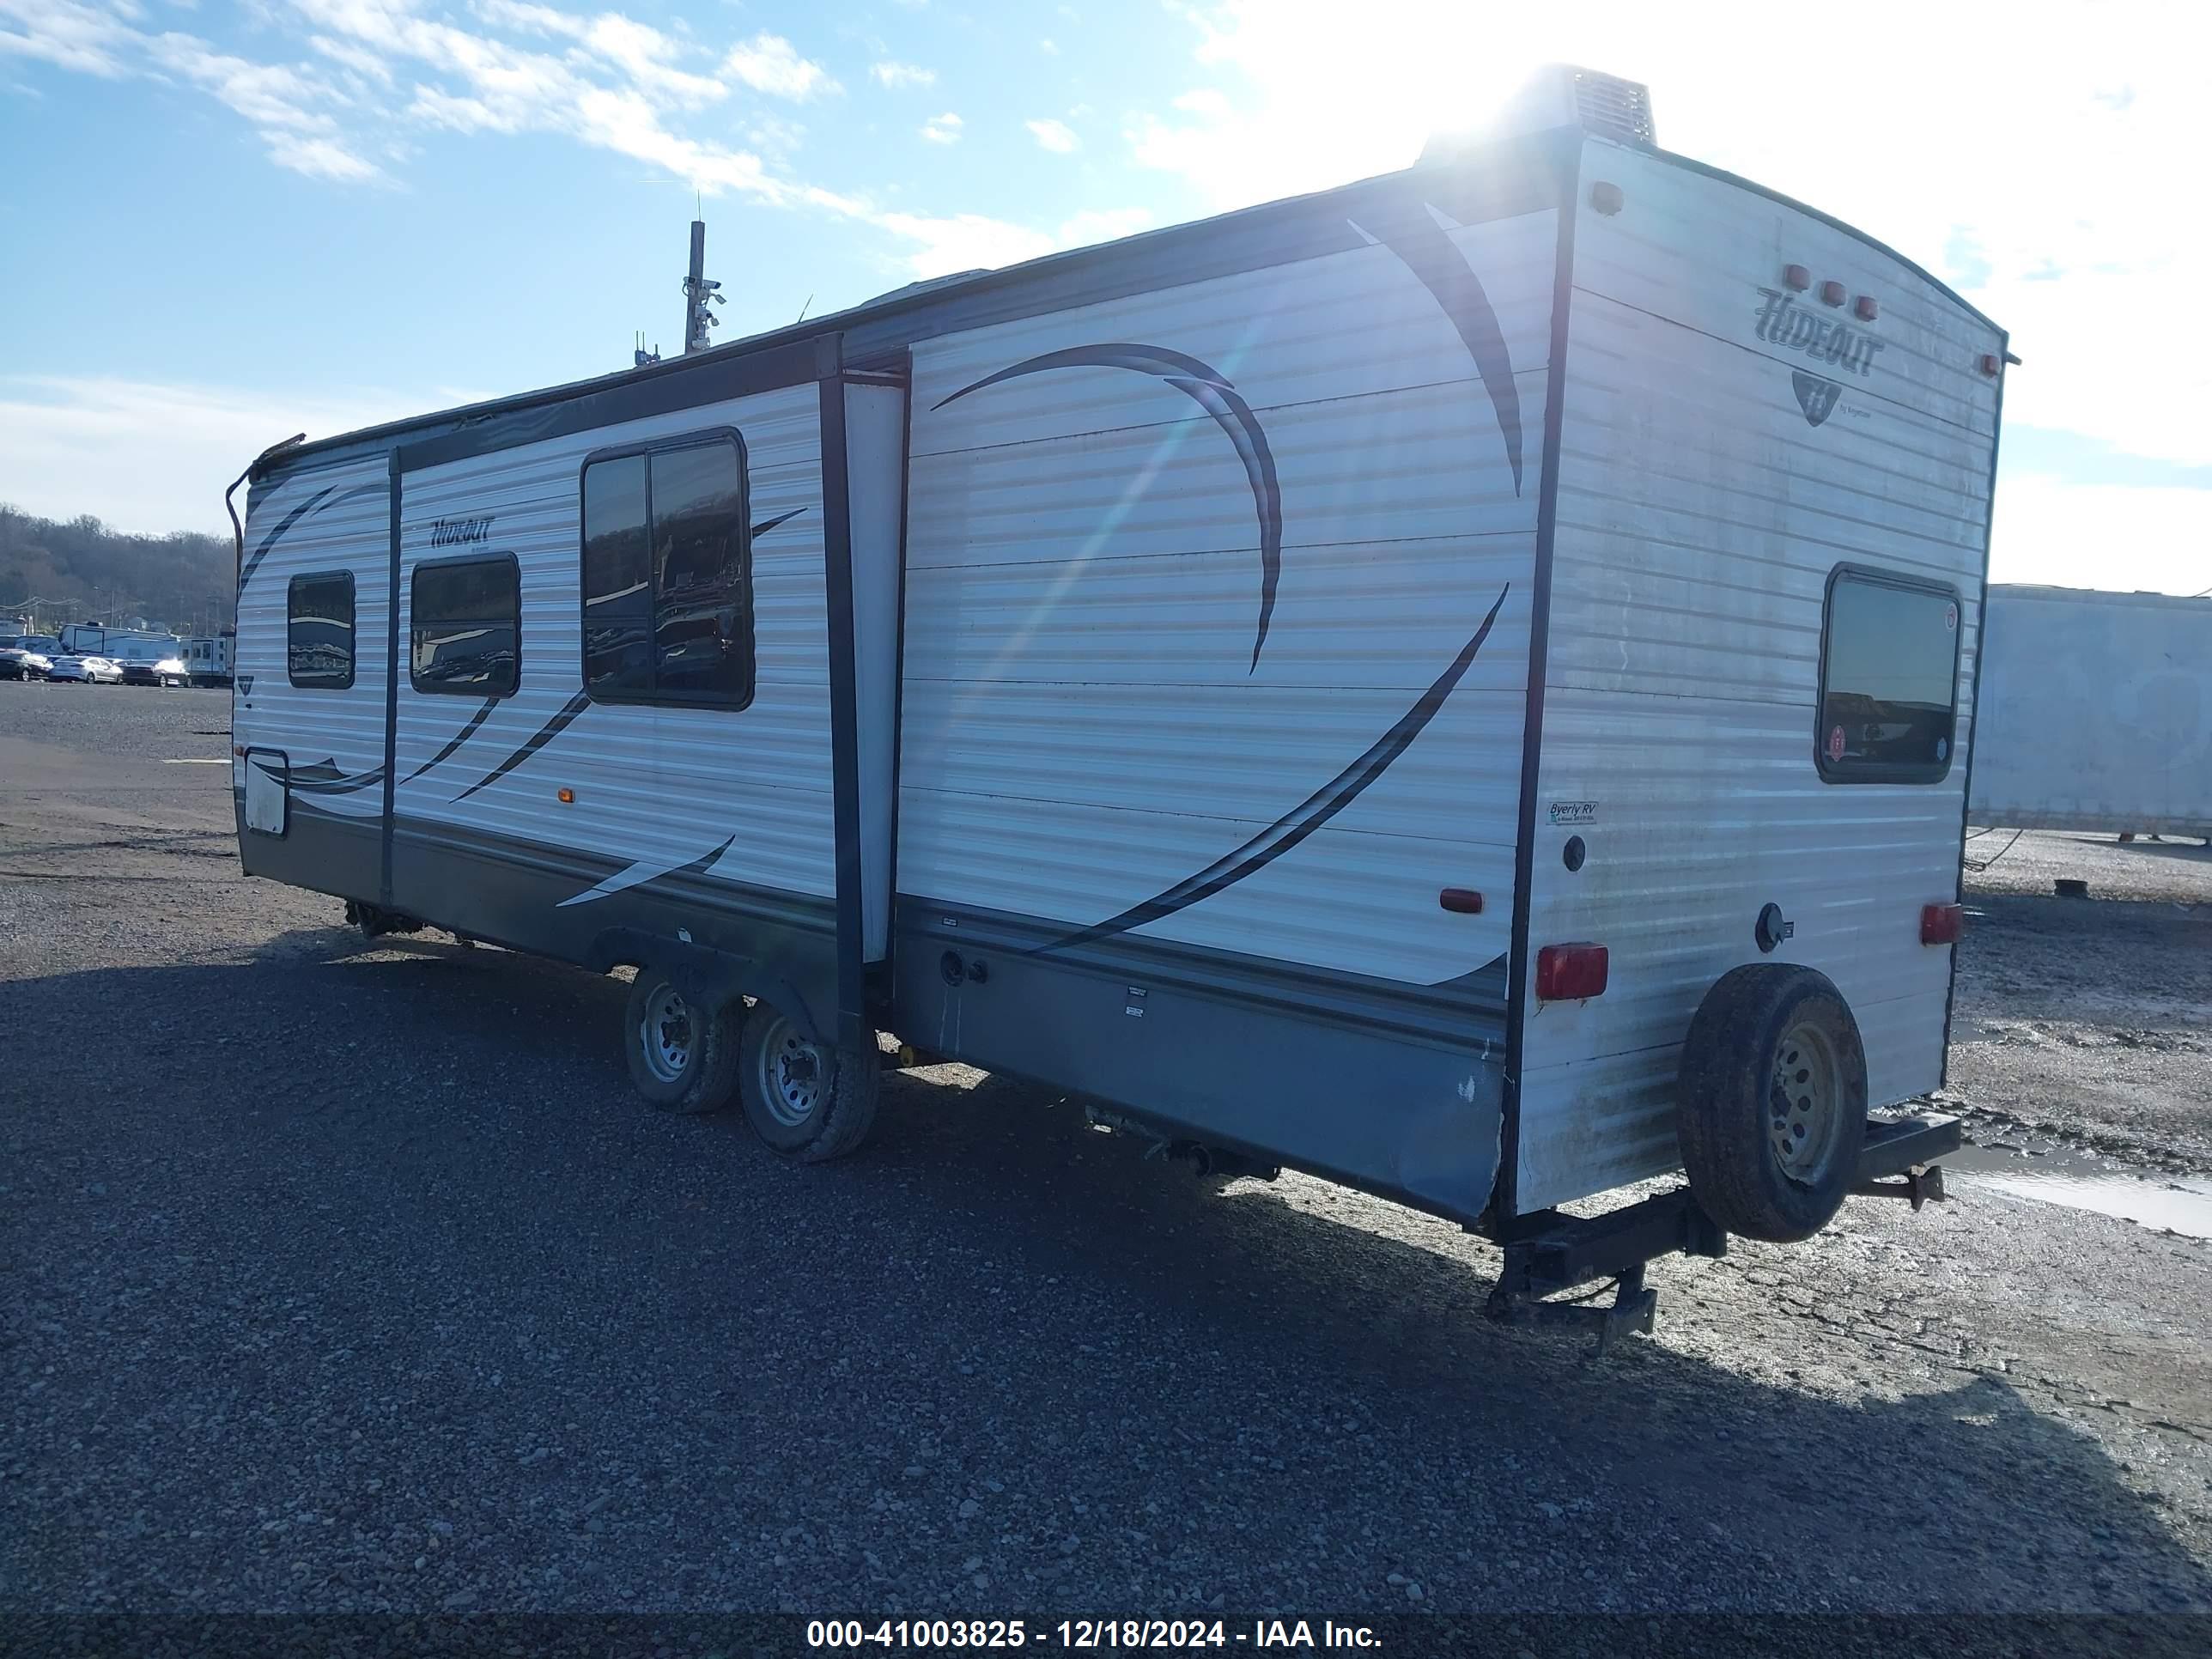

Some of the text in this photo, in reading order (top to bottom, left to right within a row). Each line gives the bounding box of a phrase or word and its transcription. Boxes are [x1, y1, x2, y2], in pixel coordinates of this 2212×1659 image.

[1754, 287, 1885, 377] HIDEOUT
[429, 516, 496, 549] HIDEOUT
[1550, 803, 1596, 817] Byerly RV
